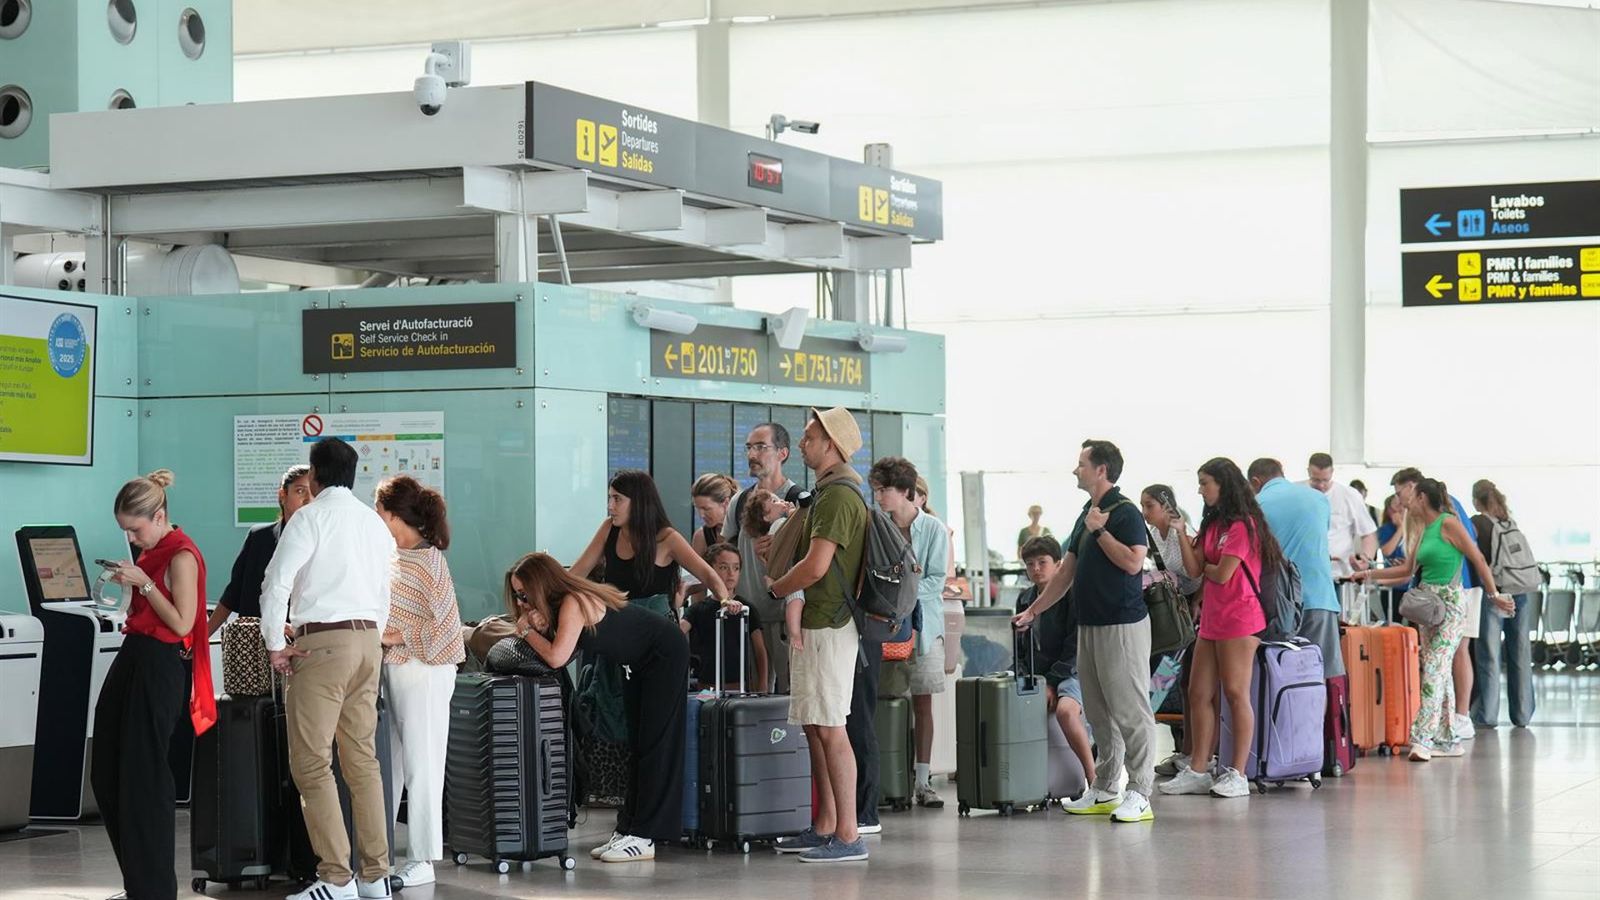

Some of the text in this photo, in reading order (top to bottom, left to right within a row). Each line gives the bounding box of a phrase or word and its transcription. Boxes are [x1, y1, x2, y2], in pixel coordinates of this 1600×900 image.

[622, 110, 657, 134] Sortides
[622, 131, 658, 153] Departures
[622, 151, 653, 173] Salidas
[1491, 194, 1544, 208] Lavabos
[1491, 208, 1526, 220] Toilets
[1491, 222, 1530, 234] Aseos
[1486, 257, 1516, 271] PMR
[1518, 256, 1523, 270] i
[1487, 270, 1559, 284] PRM & families
[1487, 284, 1516, 298] PMR
[1518, 286, 1527, 300] y
[1528, 283, 1577, 297] familias
[359, 316, 473, 332] Servei d'Autofacturació
[359, 331, 448, 344] Self Service Check in
[360, 343, 496, 358] Servicio de Autofacturación
[698, 344, 724, 374] 201
[731, 347, 757, 377] 750
[809, 354, 832, 383] 751
[839, 357, 861, 384] 764
